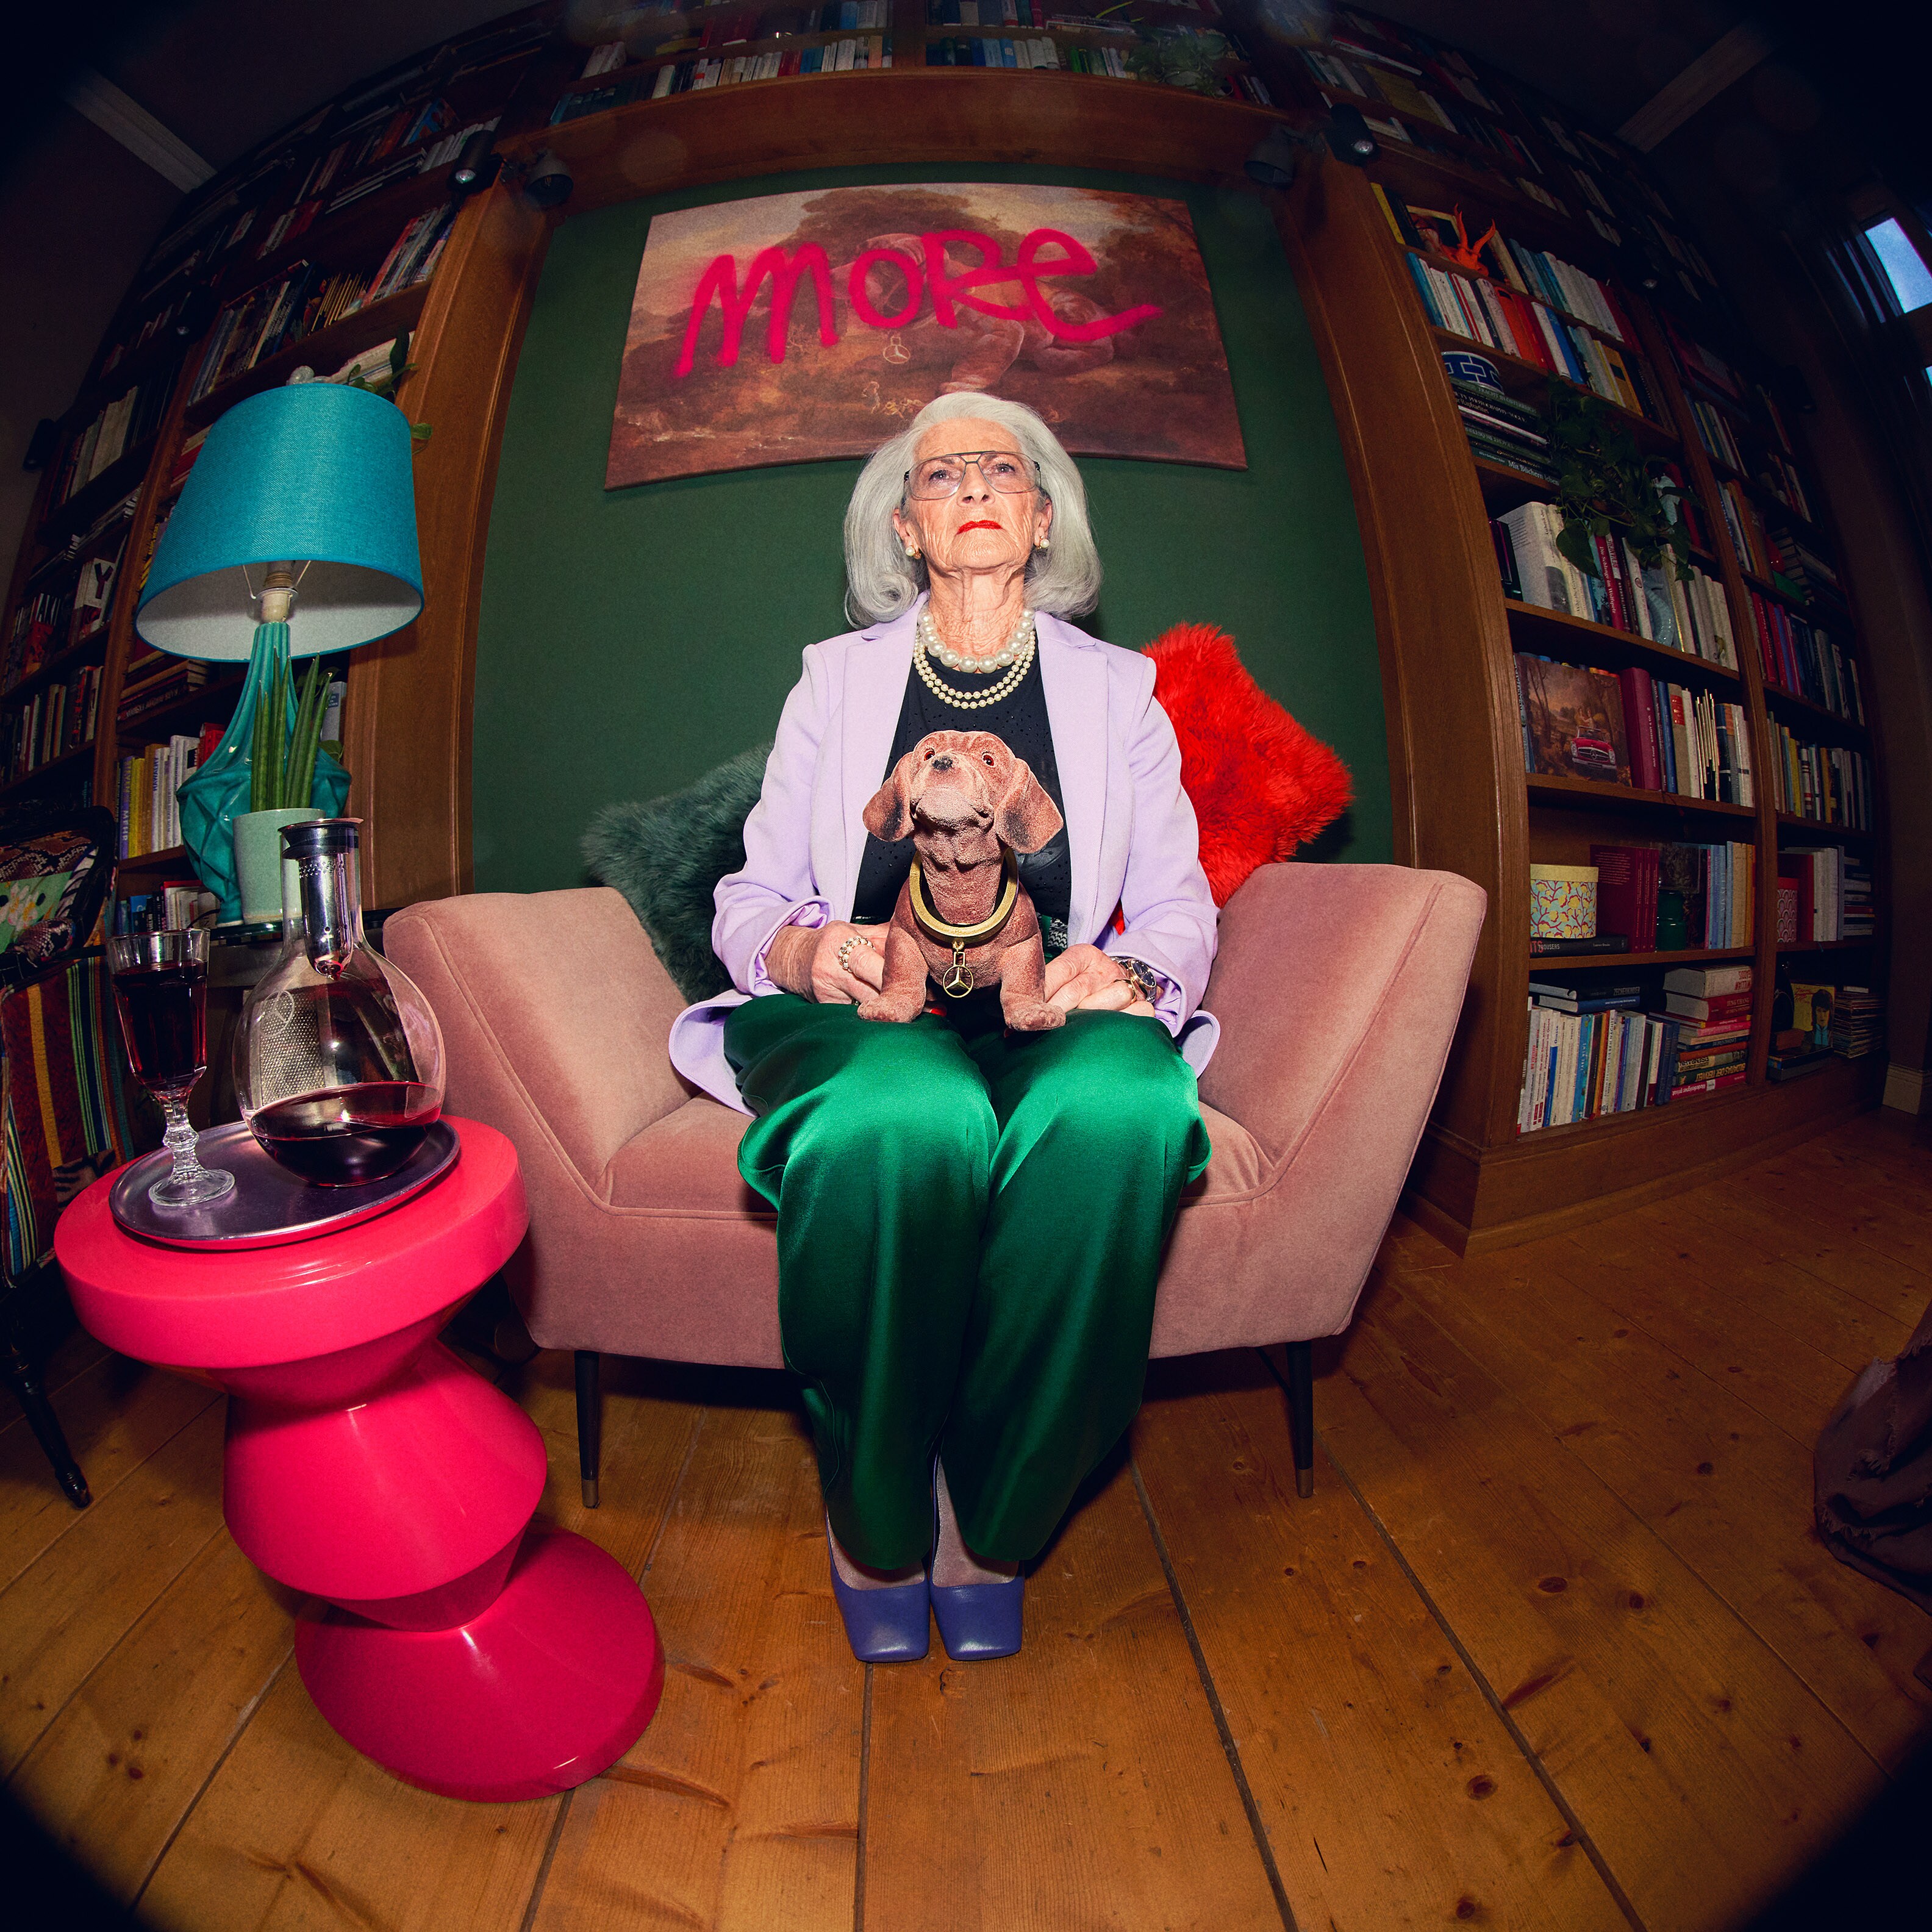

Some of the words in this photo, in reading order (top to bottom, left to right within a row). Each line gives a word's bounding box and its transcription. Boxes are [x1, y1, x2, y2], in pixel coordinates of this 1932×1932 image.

[1600, 556, 1610, 579] Schlange
[1607, 588, 1617, 614] Wolfspelz
[1683, 1084, 1705, 1092] Modedesigner
